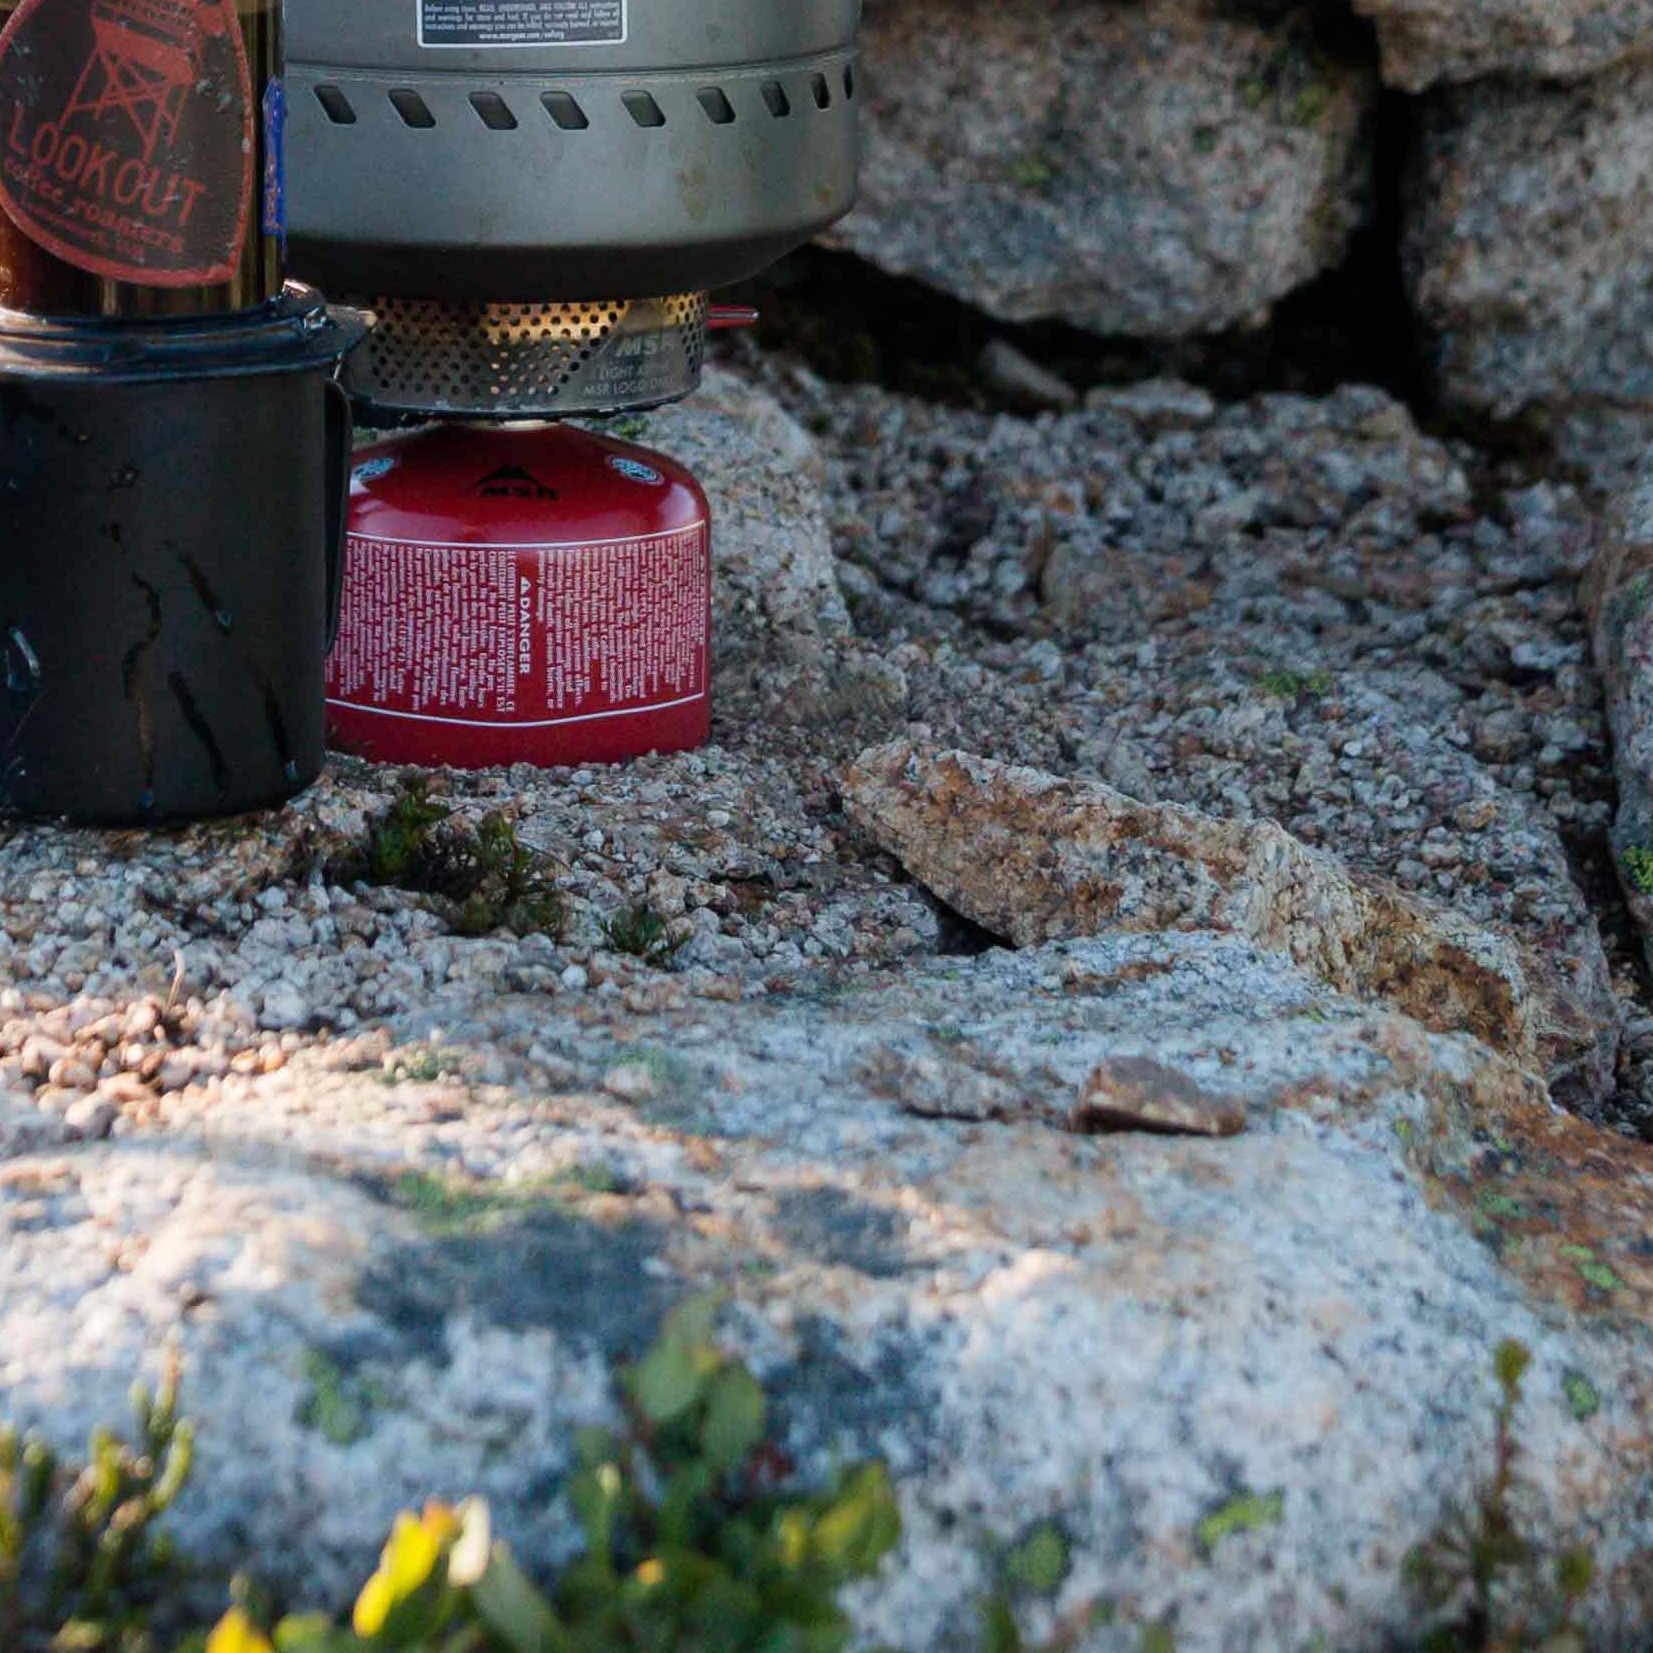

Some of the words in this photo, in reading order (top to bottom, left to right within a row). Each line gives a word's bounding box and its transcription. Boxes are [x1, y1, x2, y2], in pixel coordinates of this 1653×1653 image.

[10, 101, 207, 226] LOOKOUT
[616, 333, 675, 357] MSR
[479, 486, 560, 503] MSR
[520, 597, 531, 674] DANGER
